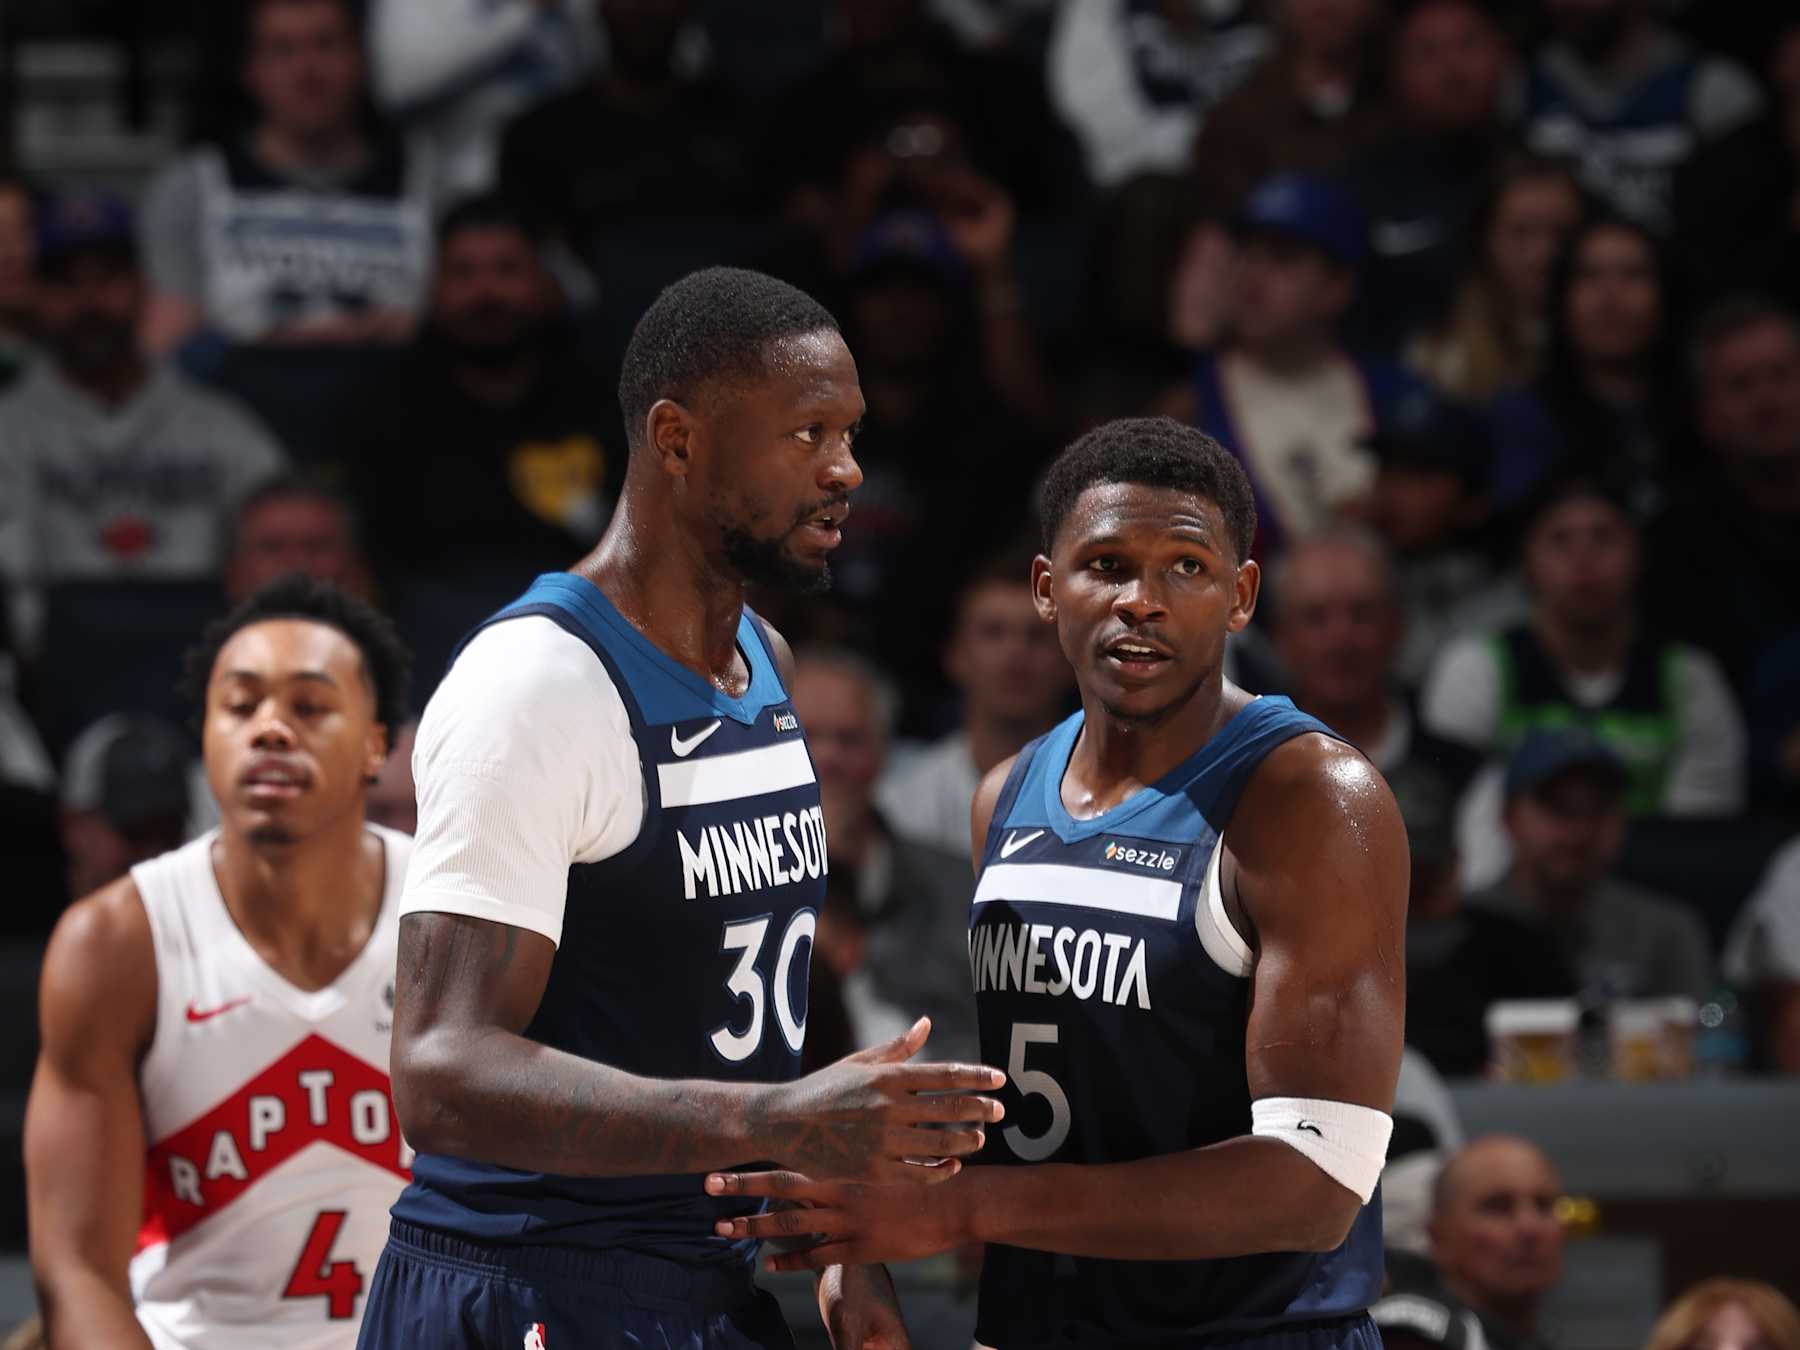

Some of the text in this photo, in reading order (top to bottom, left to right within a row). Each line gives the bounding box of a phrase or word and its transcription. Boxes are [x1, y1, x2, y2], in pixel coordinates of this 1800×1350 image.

[1115, 846, 1175, 870] sezzle
[710, 911, 816, 1062] 30
[168, 1069, 415, 1207] RAPTO
[1002, 1022, 1072, 1161] 5
[281, 1210, 363, 1320] 4
